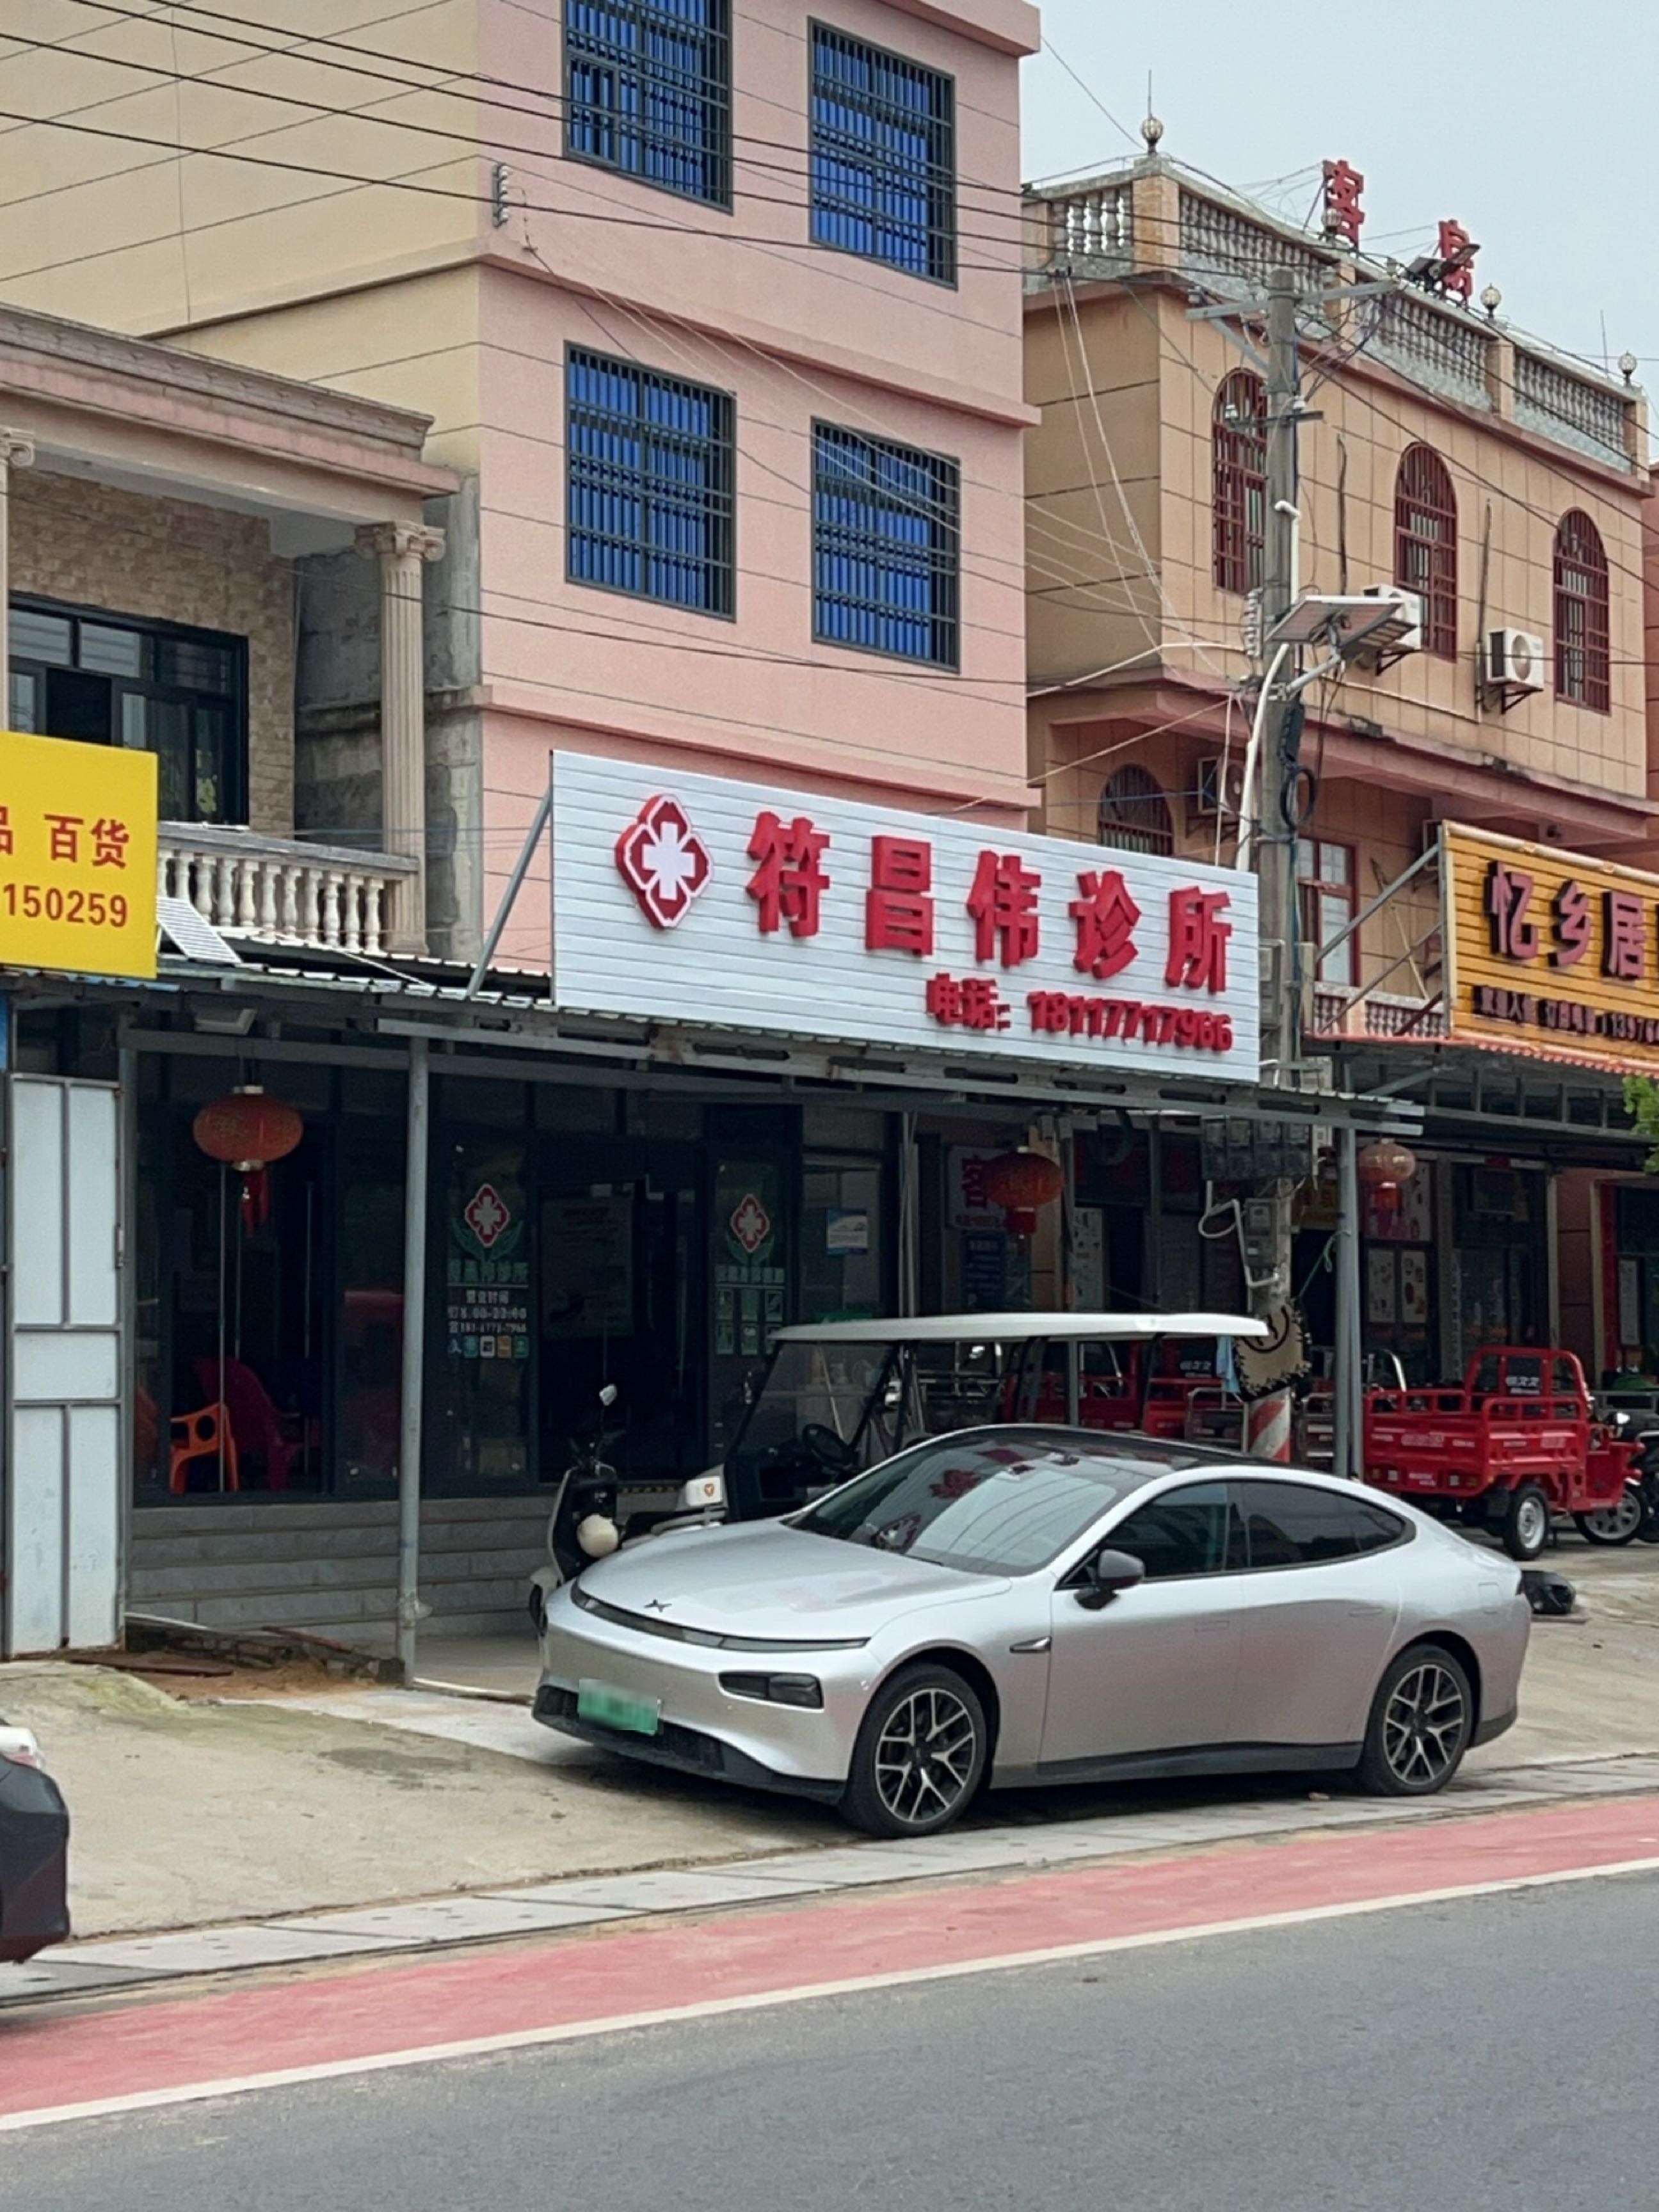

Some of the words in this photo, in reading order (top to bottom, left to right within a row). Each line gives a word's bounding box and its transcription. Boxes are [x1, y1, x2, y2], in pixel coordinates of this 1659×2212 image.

[43, 813, 129, 869] 百货
[3, 883, 127, 928] 150259
[746, 810, 1233, 993] 符昌伟诊所
[1484, 860, 1659, 981] 忆乡居
